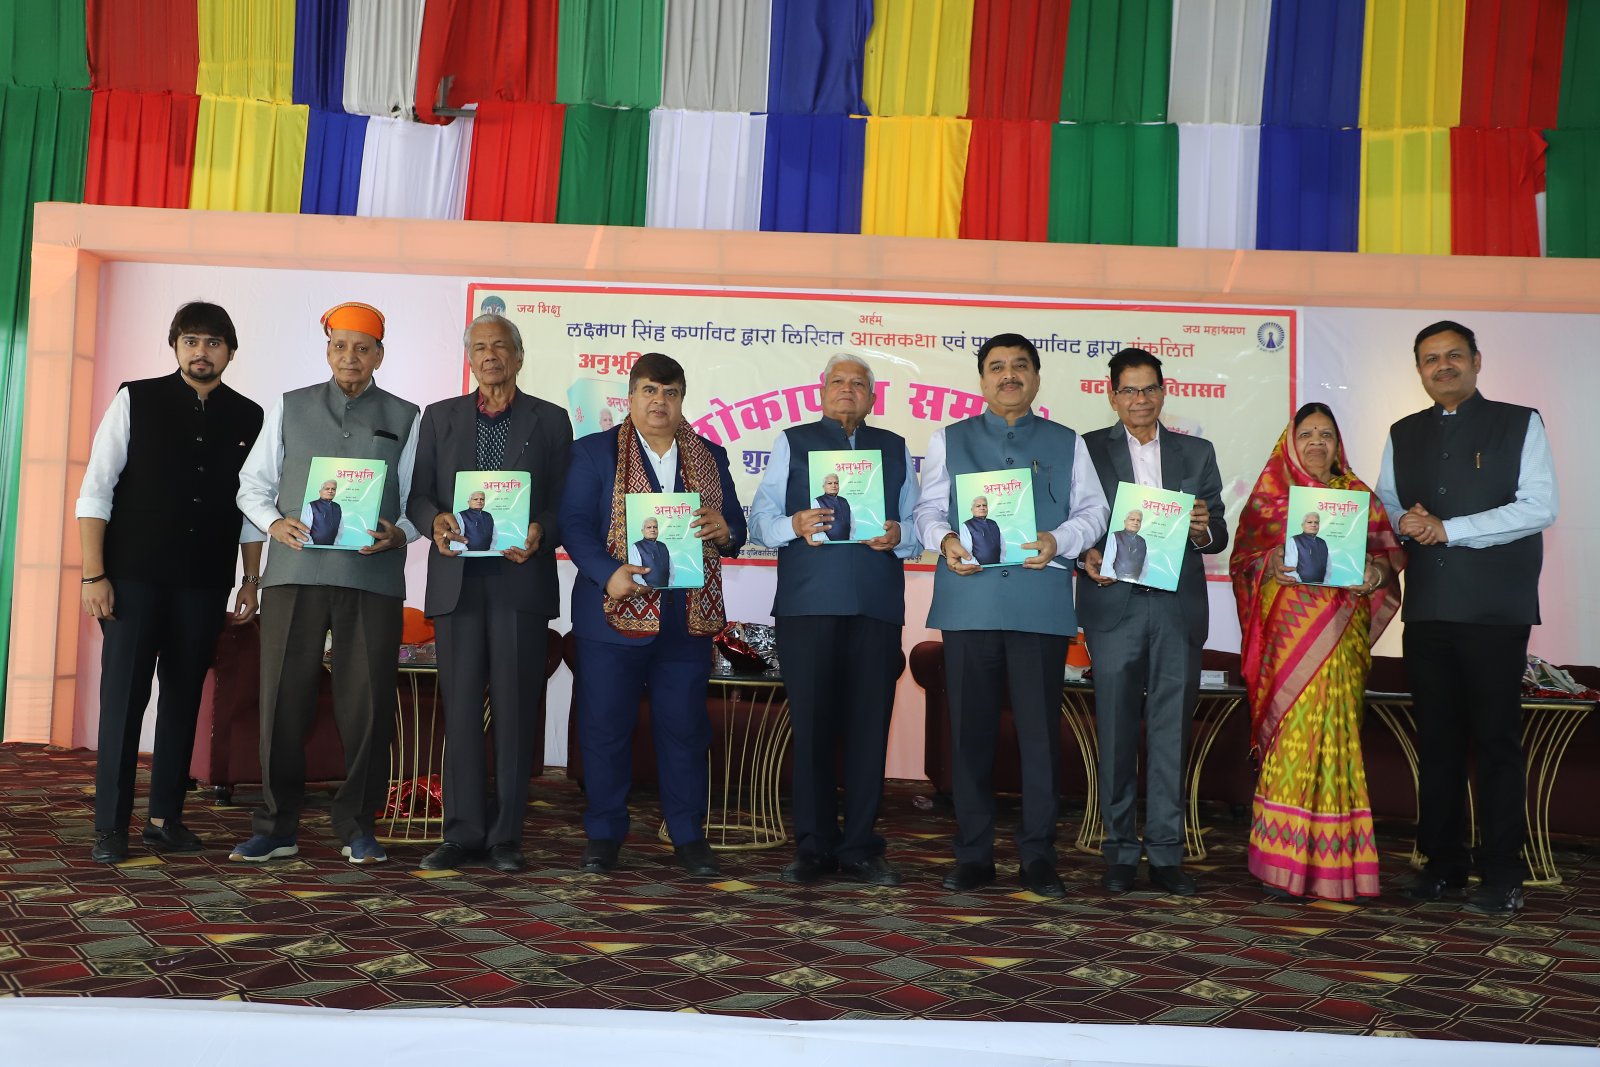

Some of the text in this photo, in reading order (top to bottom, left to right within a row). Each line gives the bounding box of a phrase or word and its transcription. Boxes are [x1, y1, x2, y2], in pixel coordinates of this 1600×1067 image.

[517, 302, 562, 317] जय भिक्षु
[859, 311, 884, 327] अर्हम्
[566, 322, 626, 341] लक्ष्मण
[631, 319, 666, 342] सिंह
[671, 321, 736, 342] कर्णावट
[741, 328, 776, 346] द्वारा
[781, 324, 845, 346] लिखित
[849, 332, 937, 348] आत्मकथा
[941, 330, 967, 352] एवं
[1086, 340, 1122, 358] द्वारा
[1183, 325, 1246, 336] जय महाश्रमण
[336, 467, 374, 483] अनुभूति
[836, 459, 873, 475] अनुभूति
[484, 479, 521, 493] अनुभूति
[984, 479, 1022, 496] अनुभूति
[654, 502, 691, 519] अनुभूति
[1142, 499, 1183, 518] अनुभूति
[1317, 500, 1359, 517] अनुभूति
